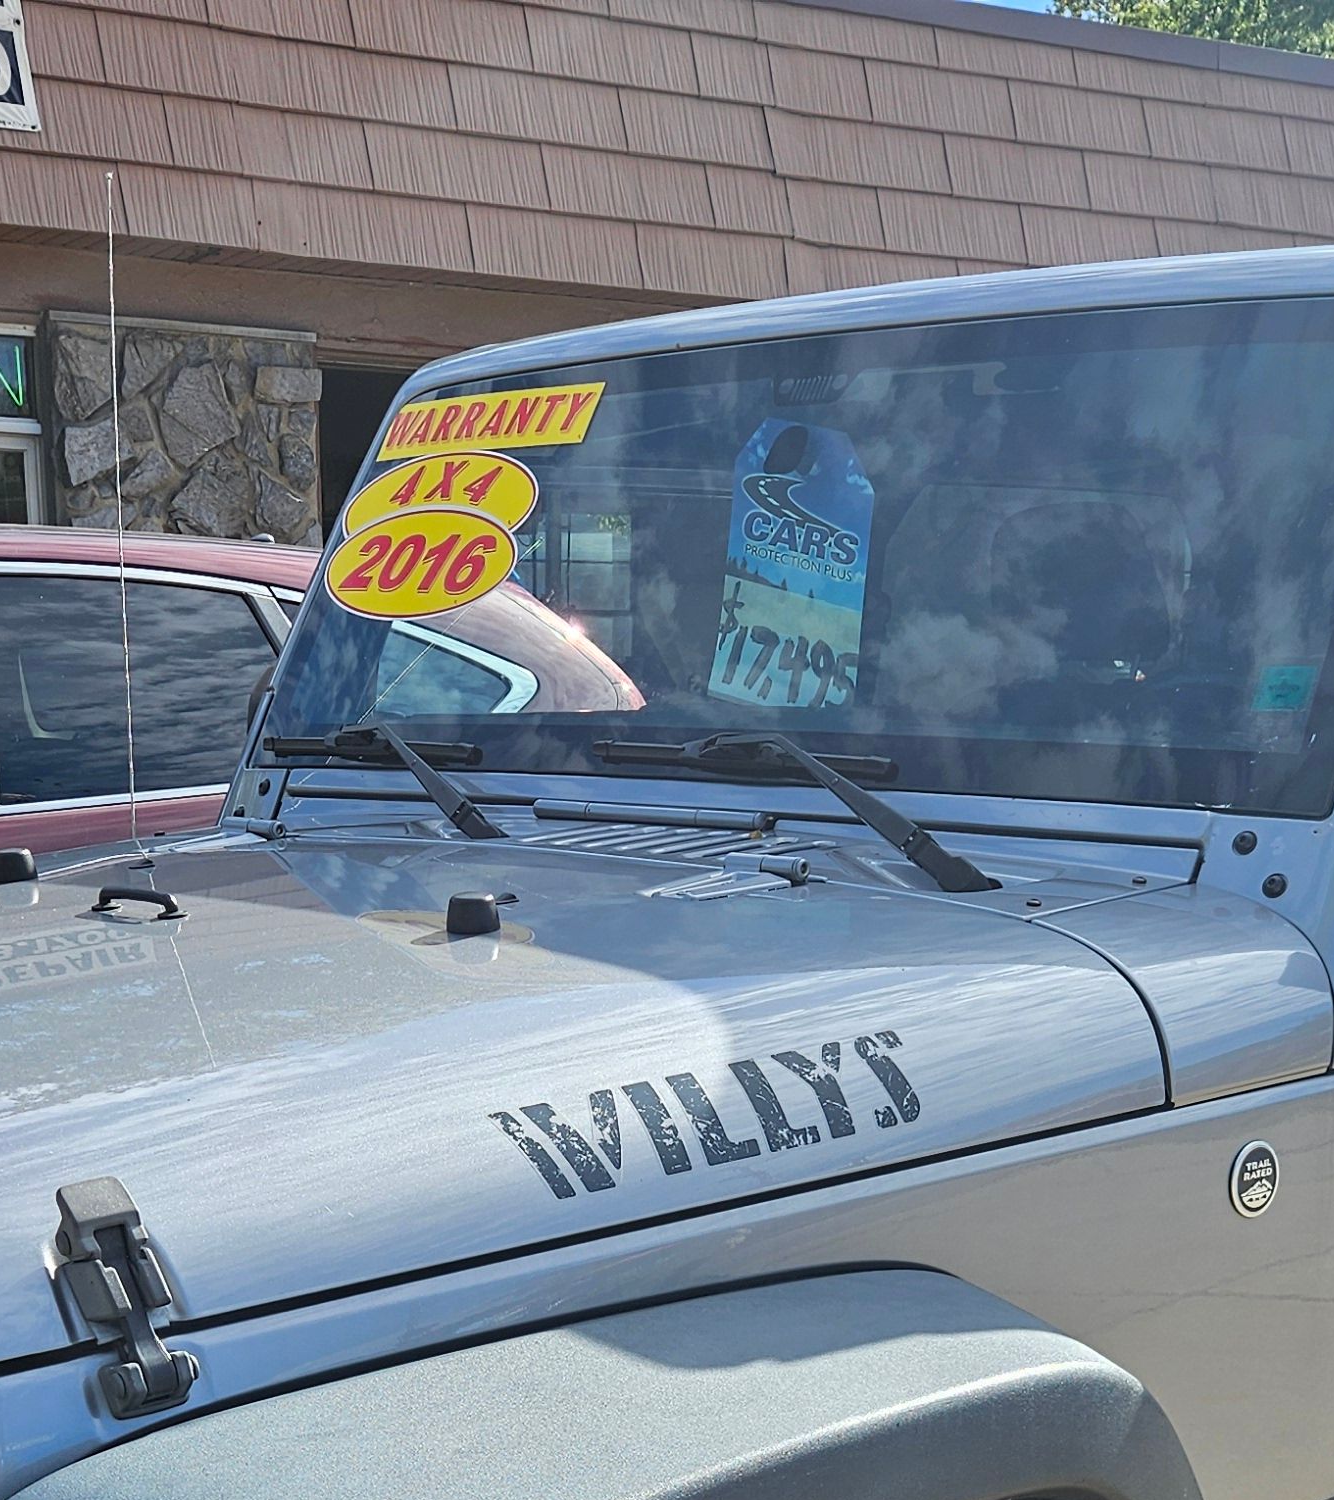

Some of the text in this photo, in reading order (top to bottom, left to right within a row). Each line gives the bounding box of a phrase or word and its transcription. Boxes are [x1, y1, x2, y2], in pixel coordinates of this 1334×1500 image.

[385, 391, 595, 449] WARRANTY
[389, 460, 503, 506] 4X4
[337, 533, 498, 595] 2016
[742, 509, 860, 566] CARS
[745, 543, 852, 582] PROTECTION PLUS
[718, 581, 859, 709] $17,495
[487, 1029, 921, 1199] WILLYS
[1243, 1167, 1273, 1181] RATED
[1245, 1158, 1272, 1171] TRAIL
